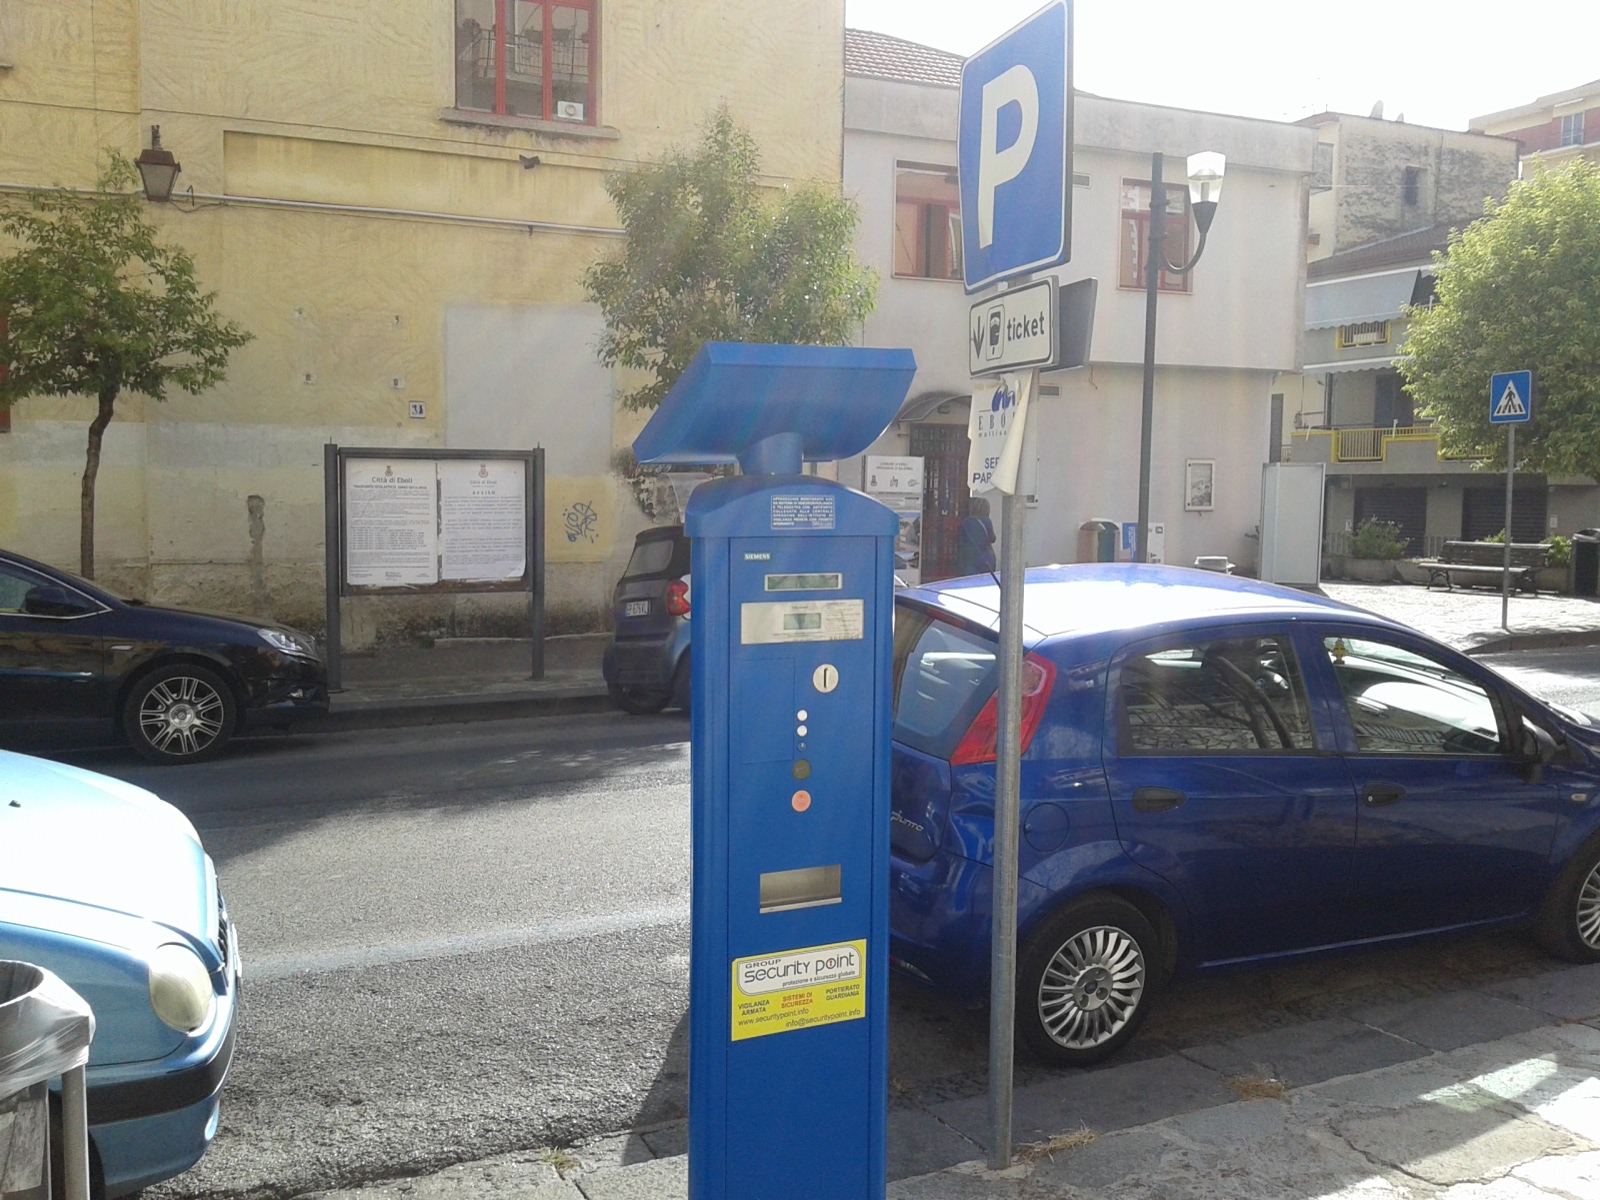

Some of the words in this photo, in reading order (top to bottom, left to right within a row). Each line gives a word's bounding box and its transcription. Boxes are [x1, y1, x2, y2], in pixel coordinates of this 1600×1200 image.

[978, 65, 1039, 249] P
[1007, 311, 1044, 341] ticket
[744, 960, 811, 984] security
[815, 952, 855, 975] point
[745, 959, 781, 969] GROUP
[782, 978, 809, 988] protezione
[814, 973, 837, 982] sicurezza
[838, 970, 855, 979] globale
[825, 984, 860, 995] PORTIERATO
[782, 993, 806, 1003] SISTEMI
[825, 991, 860, 1001] GUARDIANIA
[738, 999, 770, 1010] VIGILANZA
[781, 999, 814, 1009] SICUREZZA
[741, 1006, 767, 1016] ARMATA
